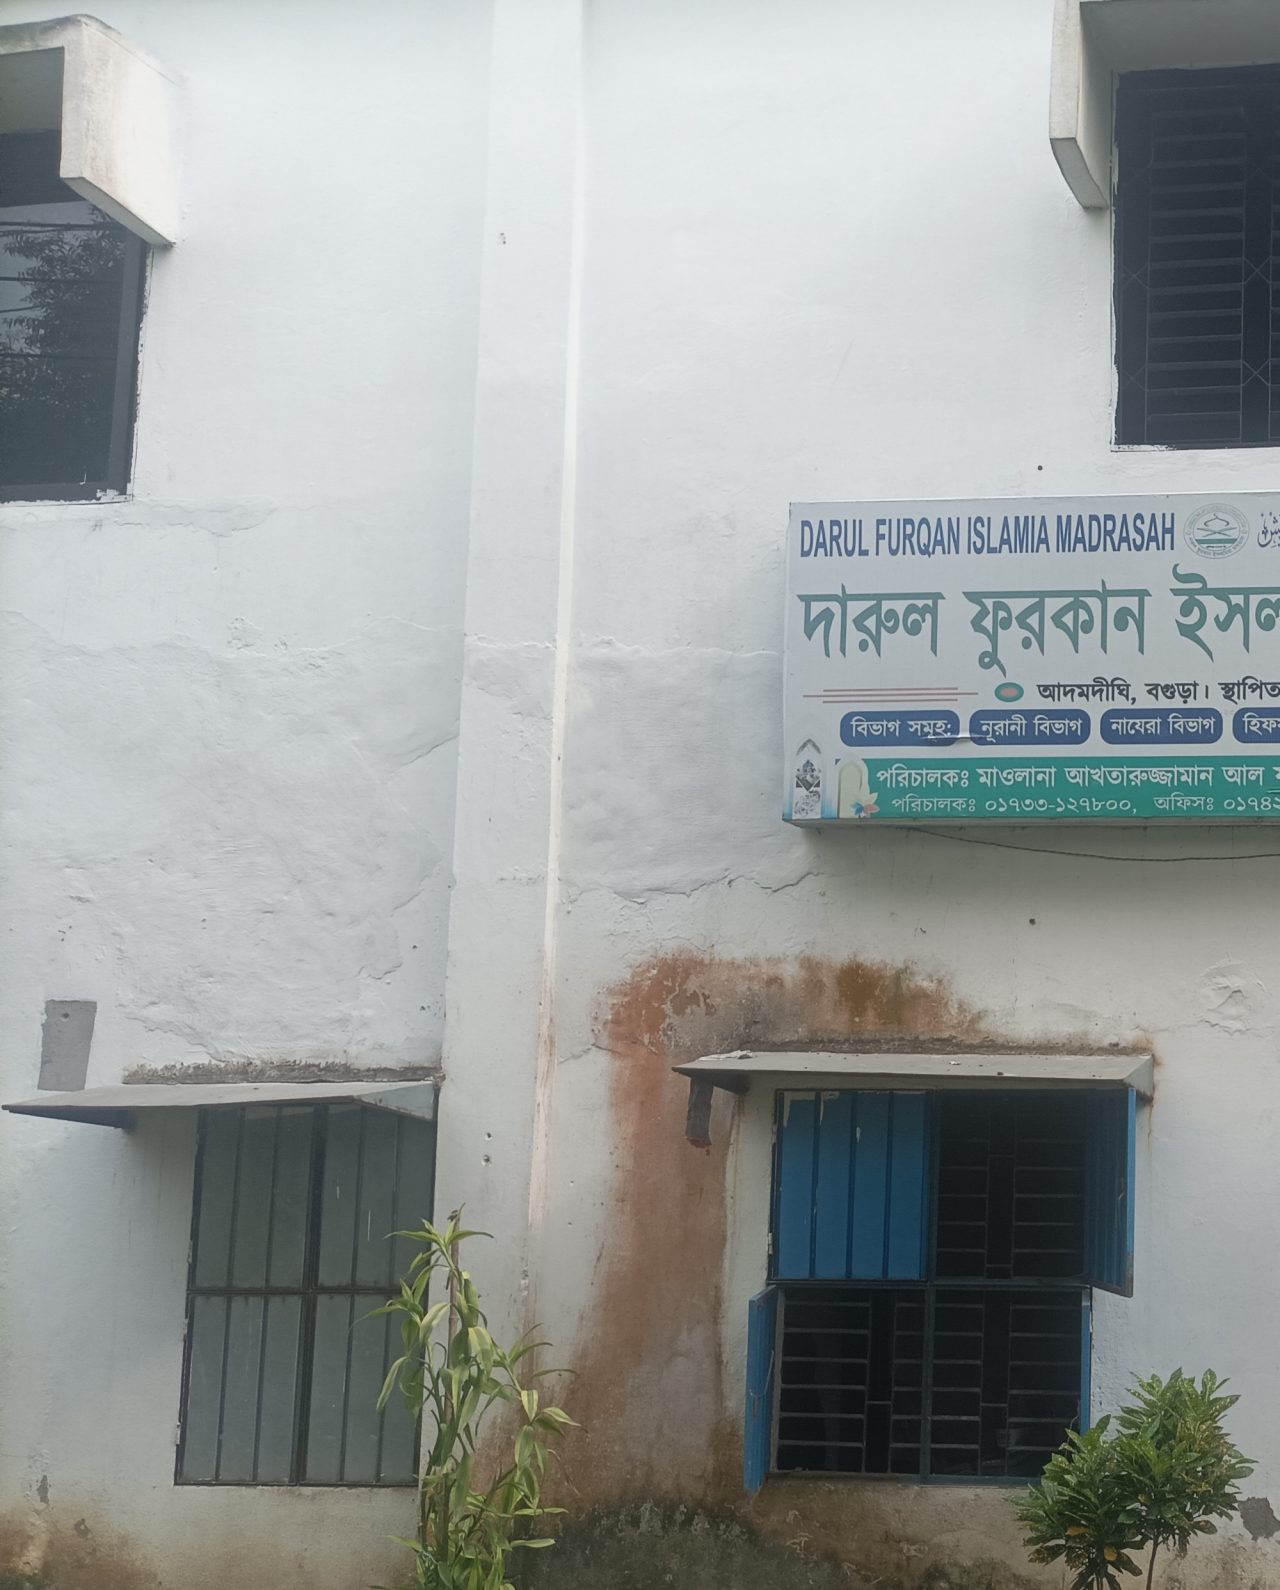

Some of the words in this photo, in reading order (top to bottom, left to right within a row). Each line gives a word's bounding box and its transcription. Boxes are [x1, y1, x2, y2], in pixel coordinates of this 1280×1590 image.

[800, 519, 869, 557] DARUL
[875, 516, 960, 557] FURQAN
[967, 514, 1050, 554] ISLAMIA
[1056, 512, 1175, 553] MADRASAH
[797, 583, 946, 658] দারুল
[962, 579, 1152, 678] ফুরকান
[1037, 676, 1136, 705] আদমদীঘি,
[851, 716, 901, 737] বিভাগ
[981, 714, 1026, 743] নূরানী
[1033, 715, 1083, 736] বিভাগ
[1110, 717, 1160, 735] নাযেরা
[1167, 713, 1216, 735] বিভাগ
[876, 763, 969, 788] পরিচালকঃ
[976, 766, 1057, 788] মাওলানা
[1064, 764, 1214, 788] আখতারুজ্জামান
[1222, 764, 1265, 786] আল
[892, 794, 976, 813] পরিচালকঃ
[986, 797, 1136, 814] ০১৭৩৩-১২৭৮০০,
[1154, 792, 1214, 812] অফিসঃ
